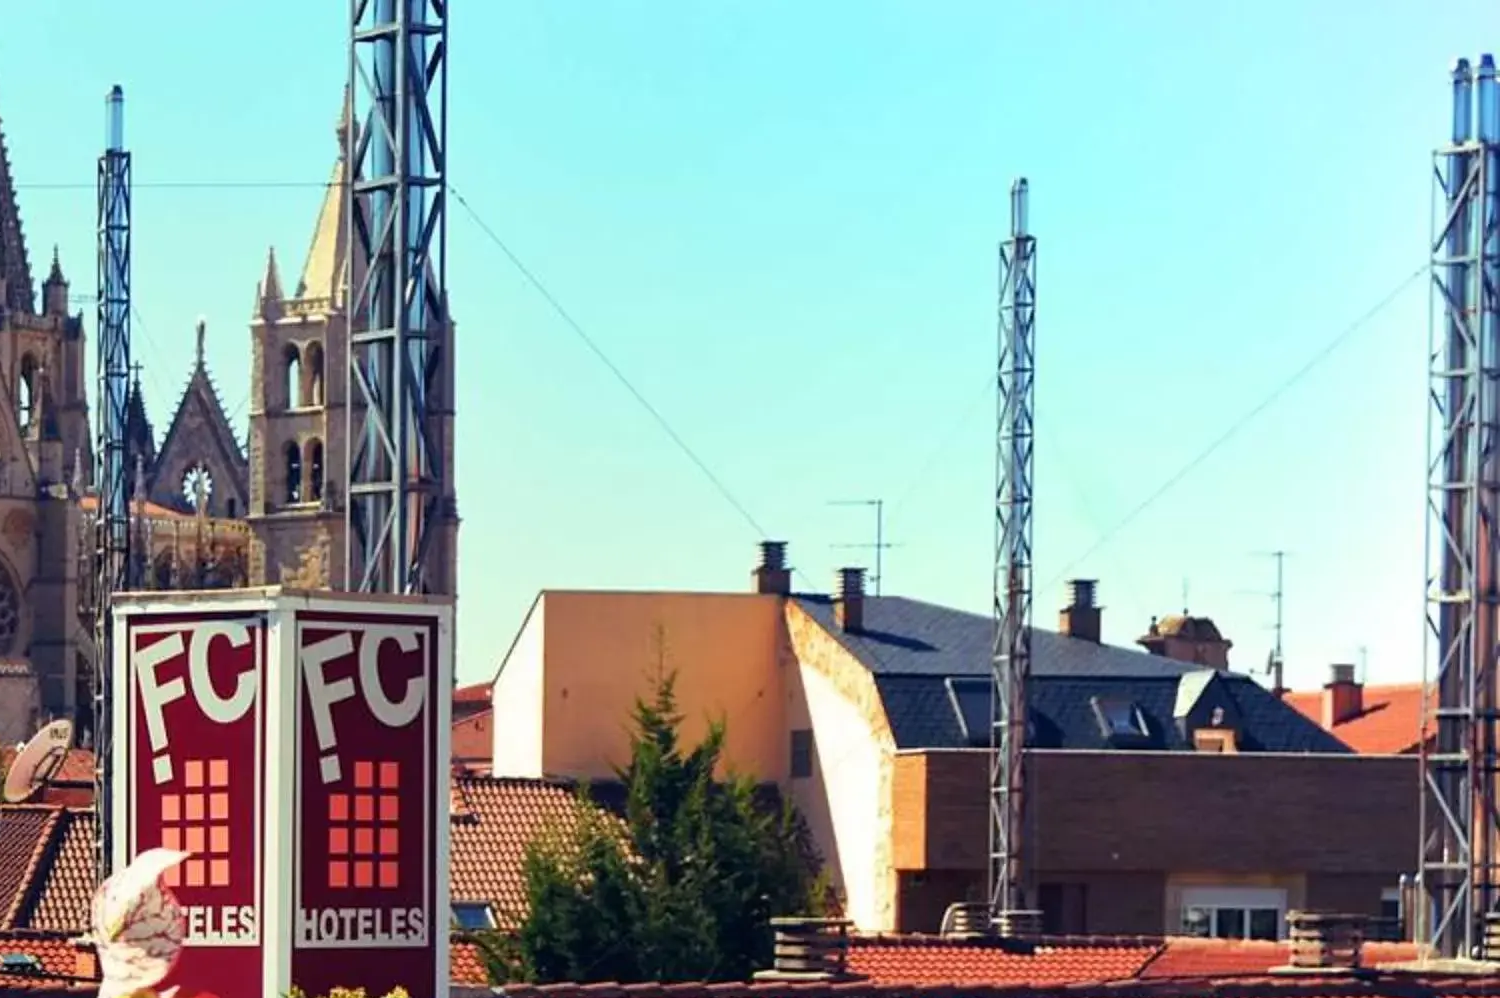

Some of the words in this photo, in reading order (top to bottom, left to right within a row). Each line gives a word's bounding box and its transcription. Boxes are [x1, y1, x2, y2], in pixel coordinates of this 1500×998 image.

[135, 621, 257, 784] FC
[301, 624, 425, 784] FC
[180, 905, 255, 940] ELES
[299, 907, 424, 942] HOTELES
